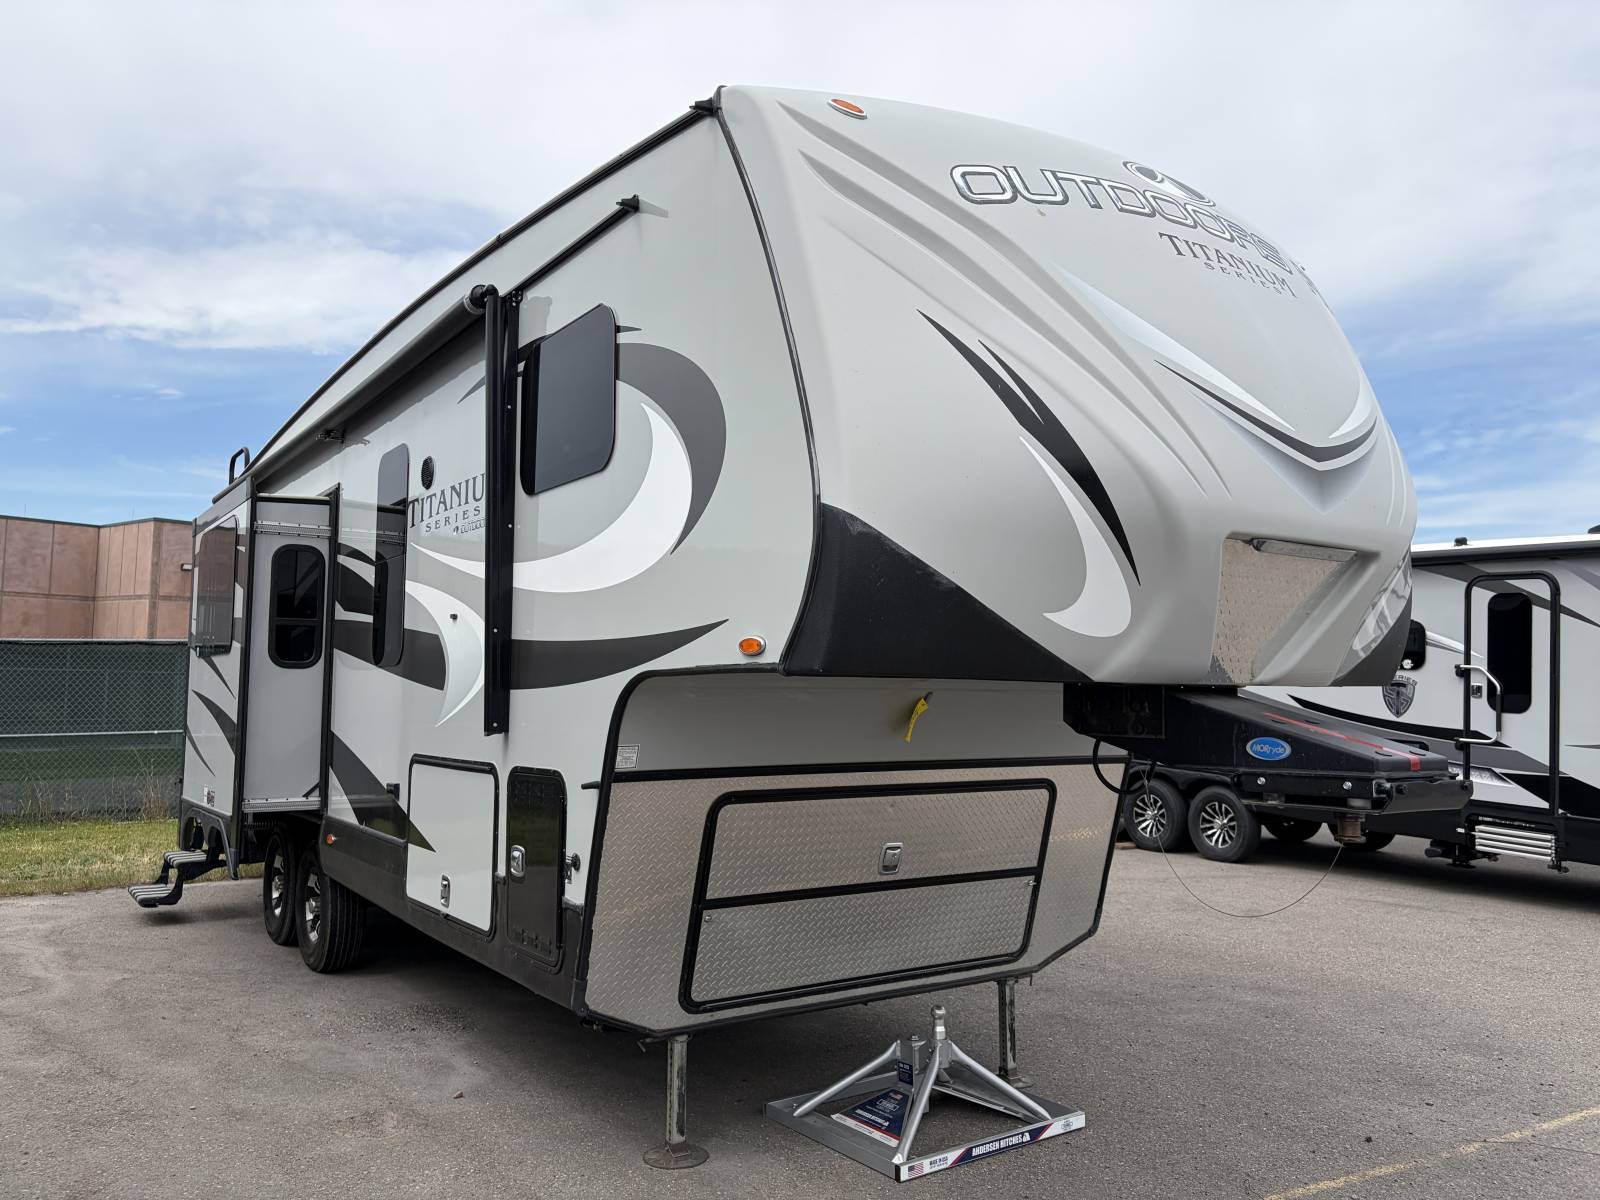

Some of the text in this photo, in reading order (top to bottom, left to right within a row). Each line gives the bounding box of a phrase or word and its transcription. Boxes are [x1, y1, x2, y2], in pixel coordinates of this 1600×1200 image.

[1158, 232, 1298, 299] TITANIUM
[1203, 261, 1282, 295] SERIES
[407, 472, 486, 529] TITANIU
[425, 505, 481, 533] SERIES
[971, 1134, 1023, 1157] ANDERSEN HITCHES
